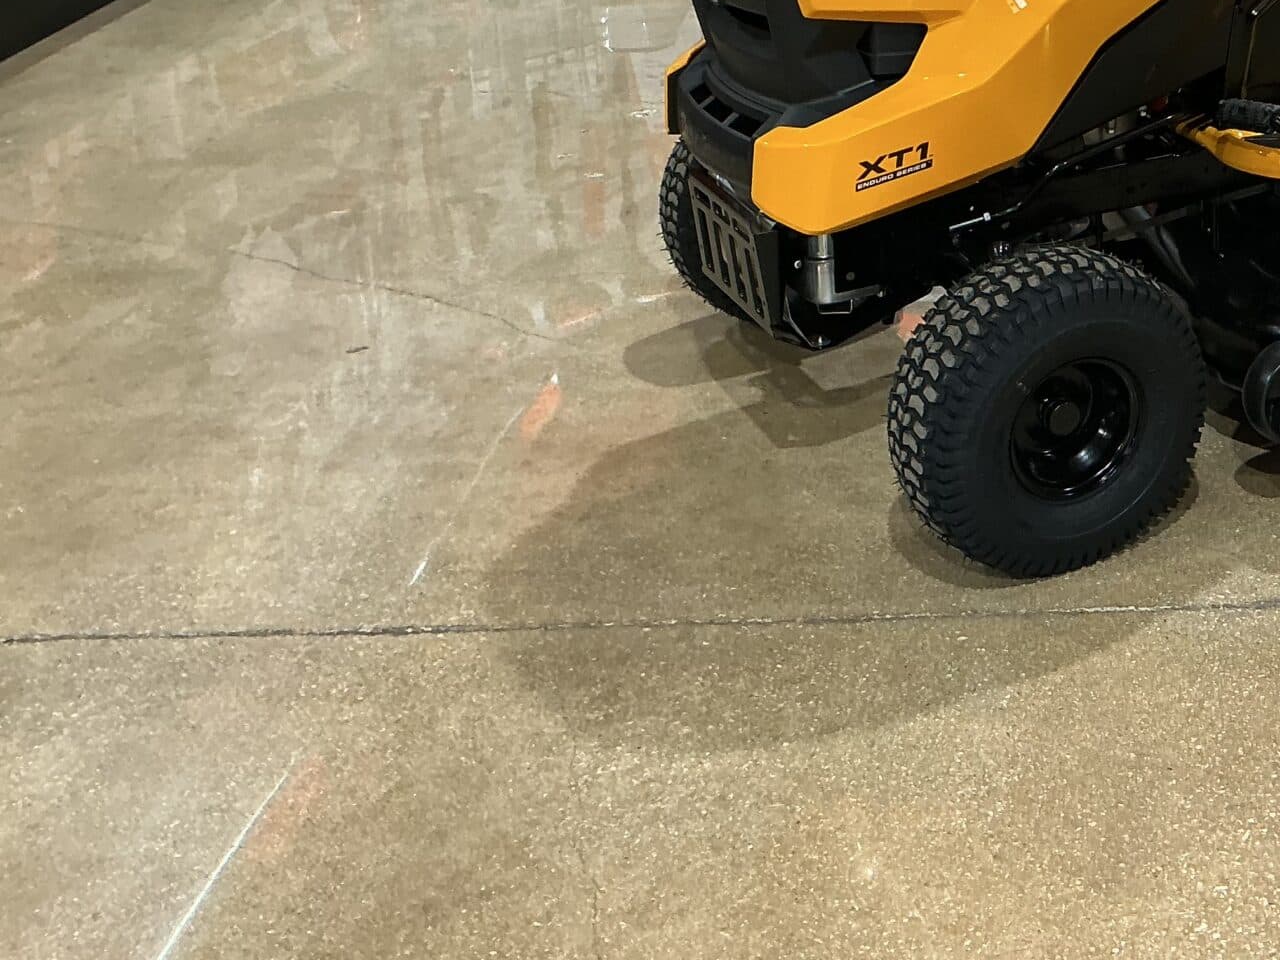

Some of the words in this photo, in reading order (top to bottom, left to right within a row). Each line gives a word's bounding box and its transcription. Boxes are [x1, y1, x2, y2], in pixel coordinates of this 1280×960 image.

[856, 141, 930, 181] XT1
[857, 173, 895, 190] ENDURO
[896, 162, 928, 177] SERIES
